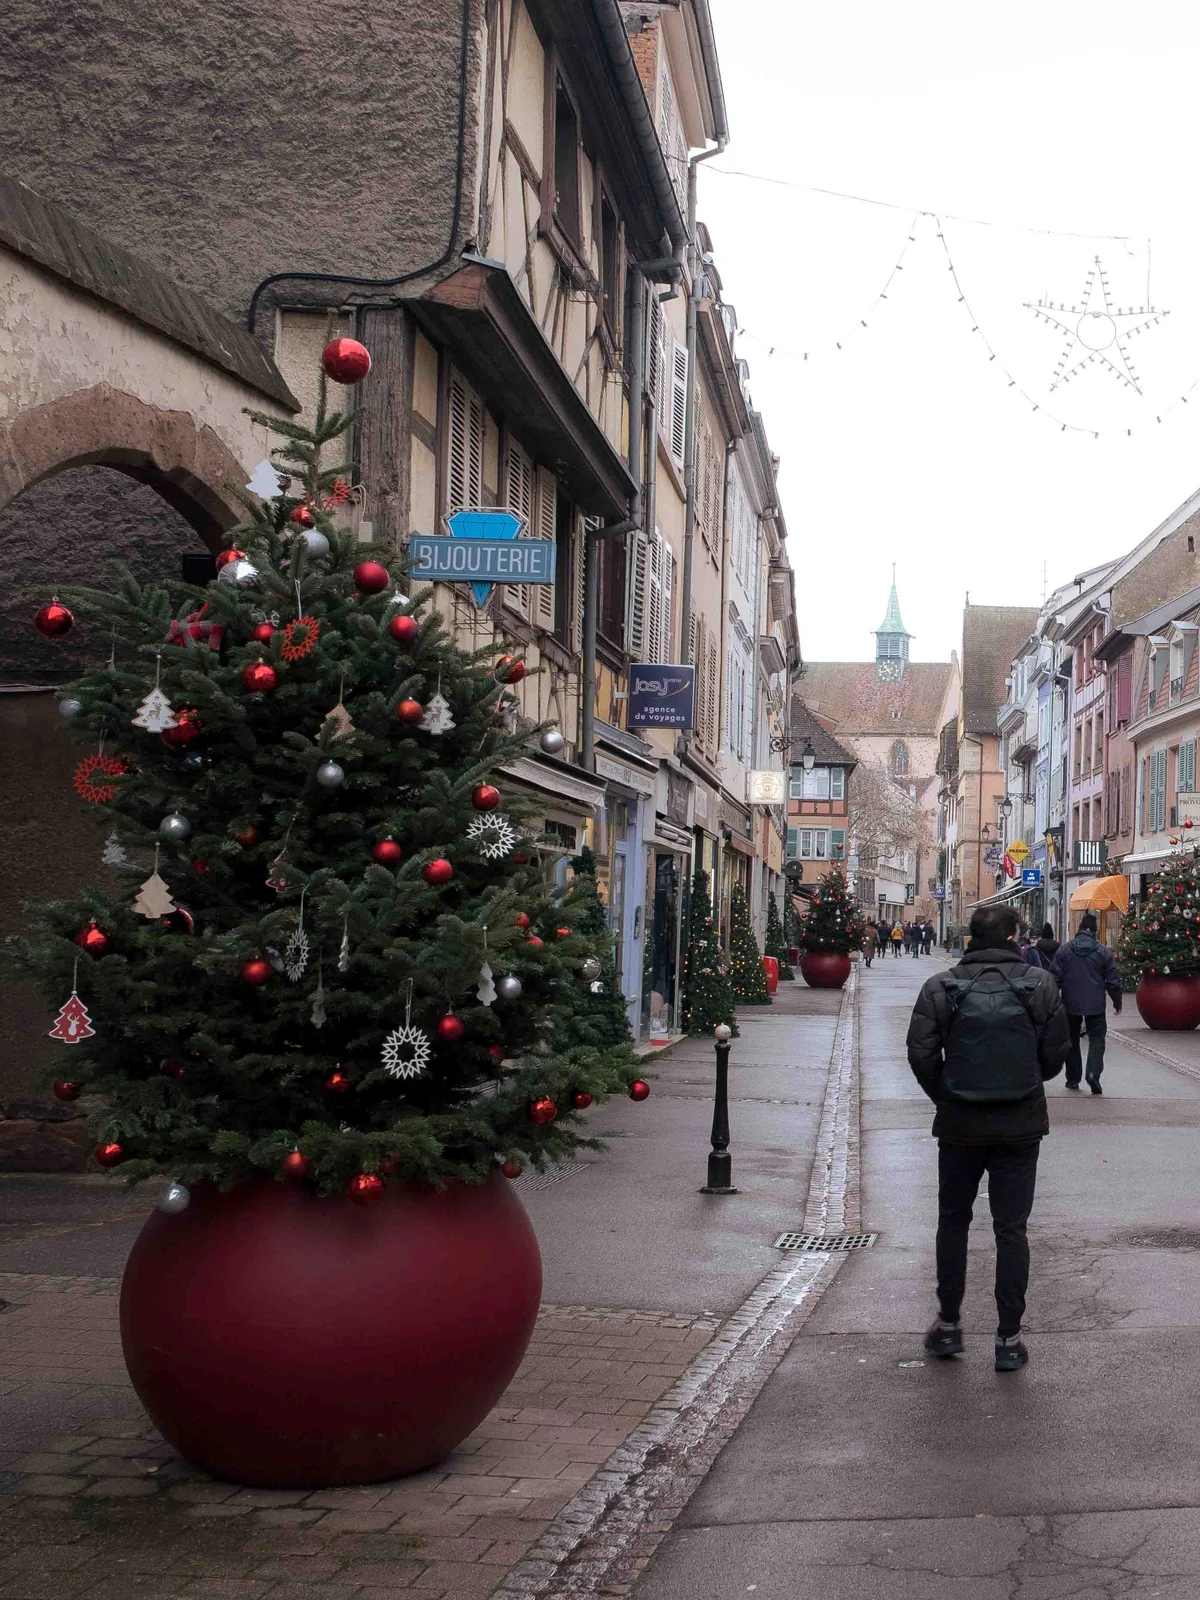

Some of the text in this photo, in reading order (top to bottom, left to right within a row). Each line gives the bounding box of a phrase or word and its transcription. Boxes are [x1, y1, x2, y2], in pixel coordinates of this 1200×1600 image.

[419, 545, 541, 573] BIJOUTERIE
[644, 706, 676, 714] agence
[649, 715, 686, 723] voyages
